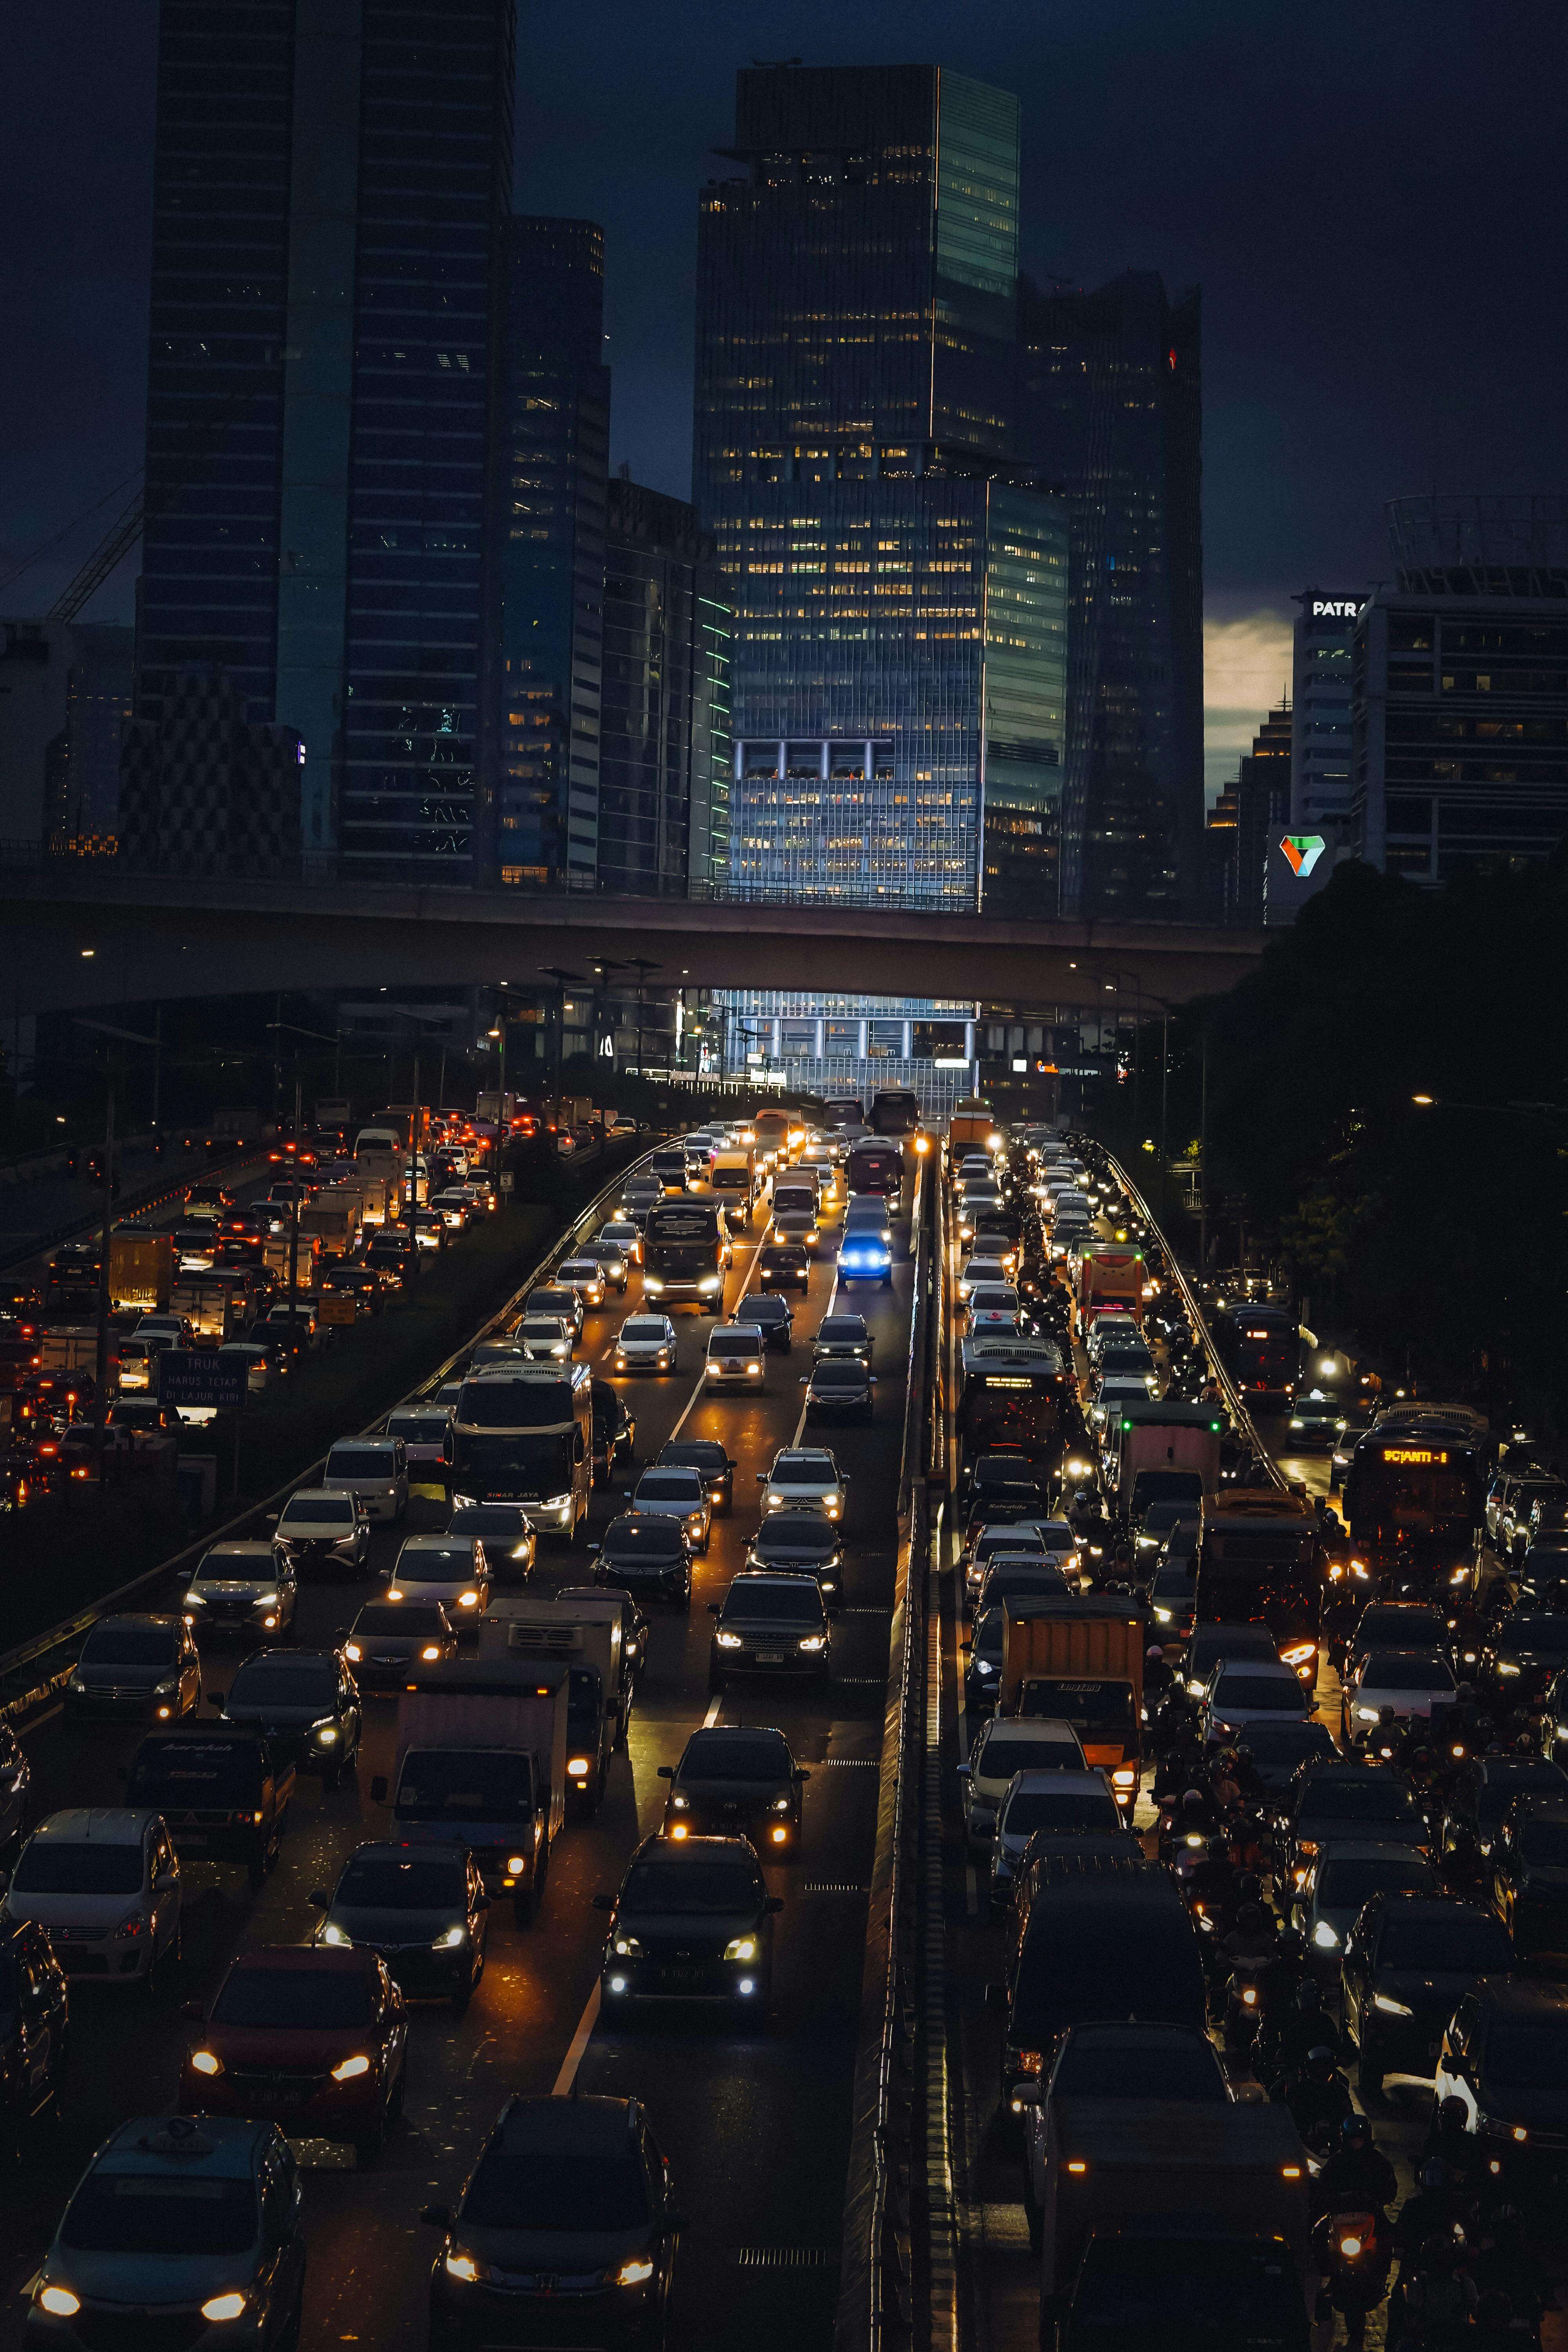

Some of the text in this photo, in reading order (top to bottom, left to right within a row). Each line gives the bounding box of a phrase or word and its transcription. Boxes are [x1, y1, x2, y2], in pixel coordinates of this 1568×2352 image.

[187, 1358, 220, 1370] TRUK
[168, 1376, 237, 1387] HARUS TETAP
[166, 1390, 239, 1402] DI LAJUR KIRI
